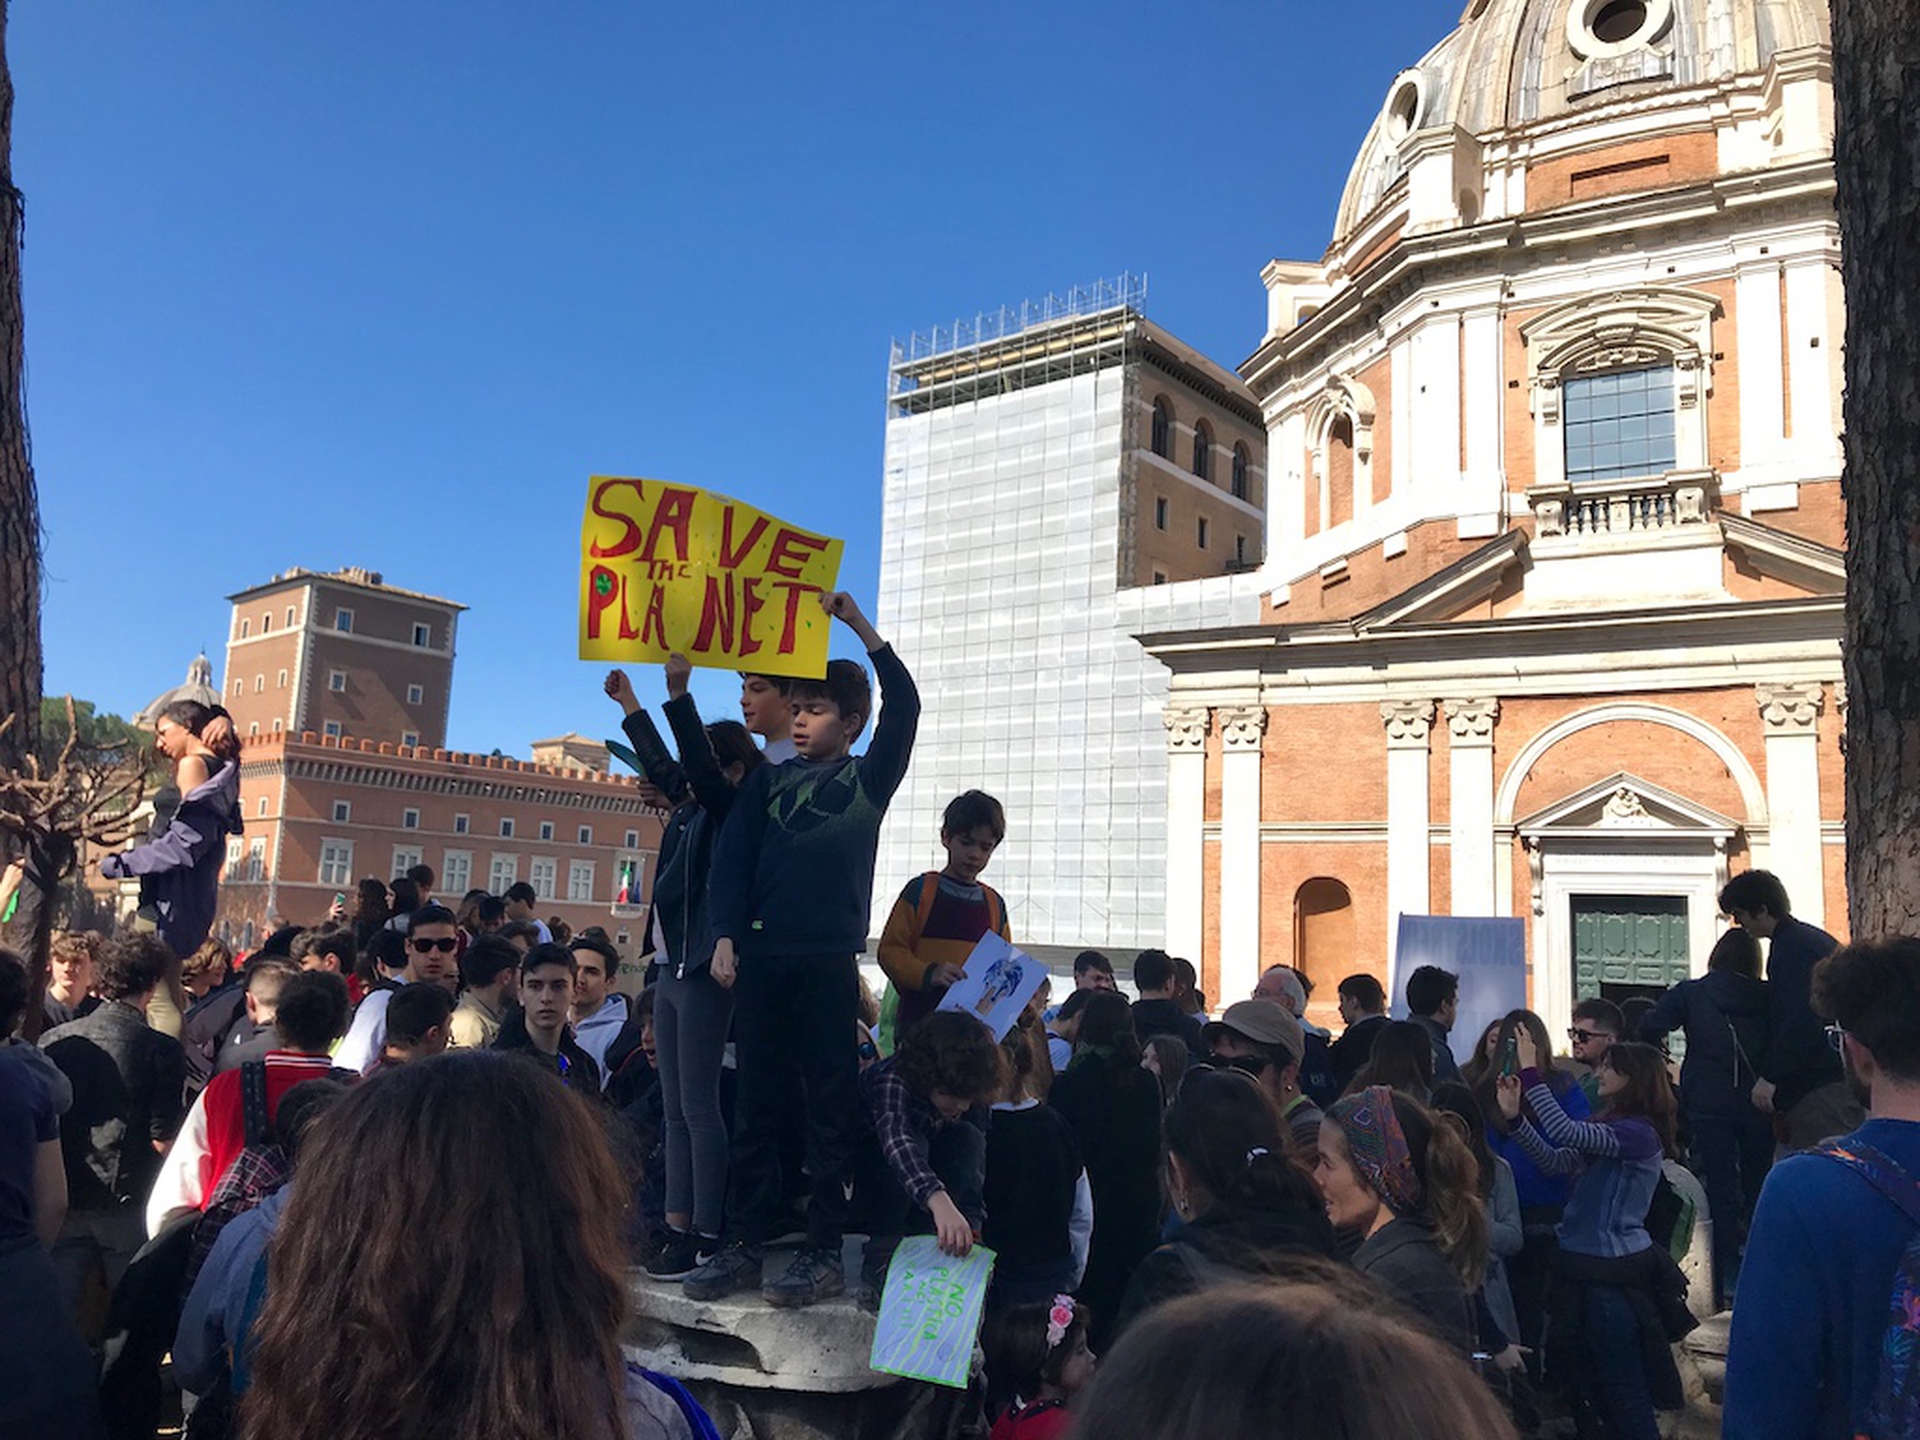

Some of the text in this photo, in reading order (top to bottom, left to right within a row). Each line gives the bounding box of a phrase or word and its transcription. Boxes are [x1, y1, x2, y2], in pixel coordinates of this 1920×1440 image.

[589, 478, 832, 578] SAVE
[587, 563, 825, 657] PLANET
[944, 1282, 966, 1318] NO
